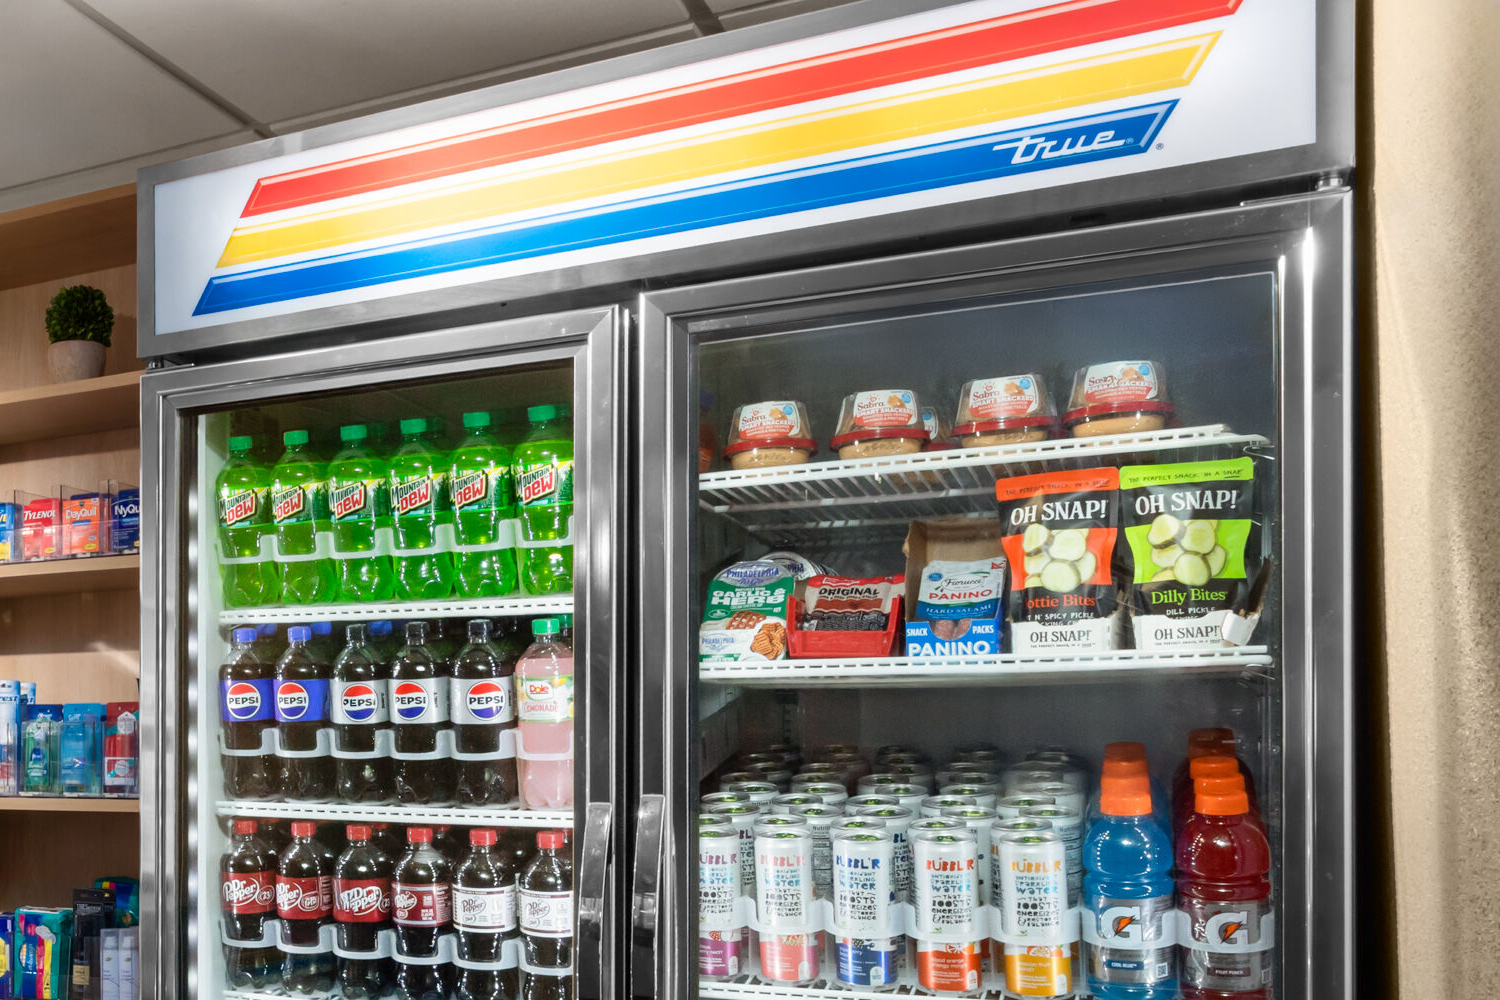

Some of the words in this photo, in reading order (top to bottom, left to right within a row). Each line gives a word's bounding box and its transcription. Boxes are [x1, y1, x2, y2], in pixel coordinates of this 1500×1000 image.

[972, 390, 1000, 401] Sabra
[857, 401, 885, 409] Sabra
[741, 414, 766, 424] Sabra
[1143, 474, 1172, 482] PERFECT
[1135, 495, 1165, 516] OH
[1170, 489, 1237, 512] SNAP!
[23, 509, 56, 520] TYLENOL
[65, 506, 97, 519] DayQuil
[1010, 505, 1037, 526] OH
[1040, 499, 1107, 521] SNAP!
[726, 566, 780, 579] PHILADELPHIA
[943, 577, 983, 587] Fiorucci
[712, 590, 775, 599] GARLIC
[818, 586, 880, 597] ORIGINAL
[928, 588, 993, 601] PANINO
[1151, 589, 1187, 606] Dilly
[1190, 587, 1227, 602] Bites
[710, 594, 786, 606] HERB
[1062, 592, 1096, 608] Bites
[925, 606, 954, 614] HARD
[956, 603, 992, 613] SALAMI
[1166, 608, 1185, 617] DILL
[1044, 613, 1068, 622] SPICY
[1070, 611, 1095, 621] PICKLE
[906, 627, 928, 637] SNACK
[972, 624, 995, 635] PACKS
[1154, 628, 1173, 641] OH
[1177, 624, 1221, 639] SNAP!
[1030, 631, 1049, 643] OH
[1051, 629, 1090, 643] SNAP!
[908, 639, 992, 657] PANINO
[529, 684, 550, 695] Dole
[228, 696, 260, 706] PEPSI
[278, 696, 308, 706] PEPSI
[395, 696, 426, 705] PEPSI
[468, 696, 504, 706] PEPSI
[523, 703, 558, 713] LEMONADE
[224, 881, 257, 904] Pepper
[1102, 906, 1142, 944] G
[1205, 911, 1248, 945] G
